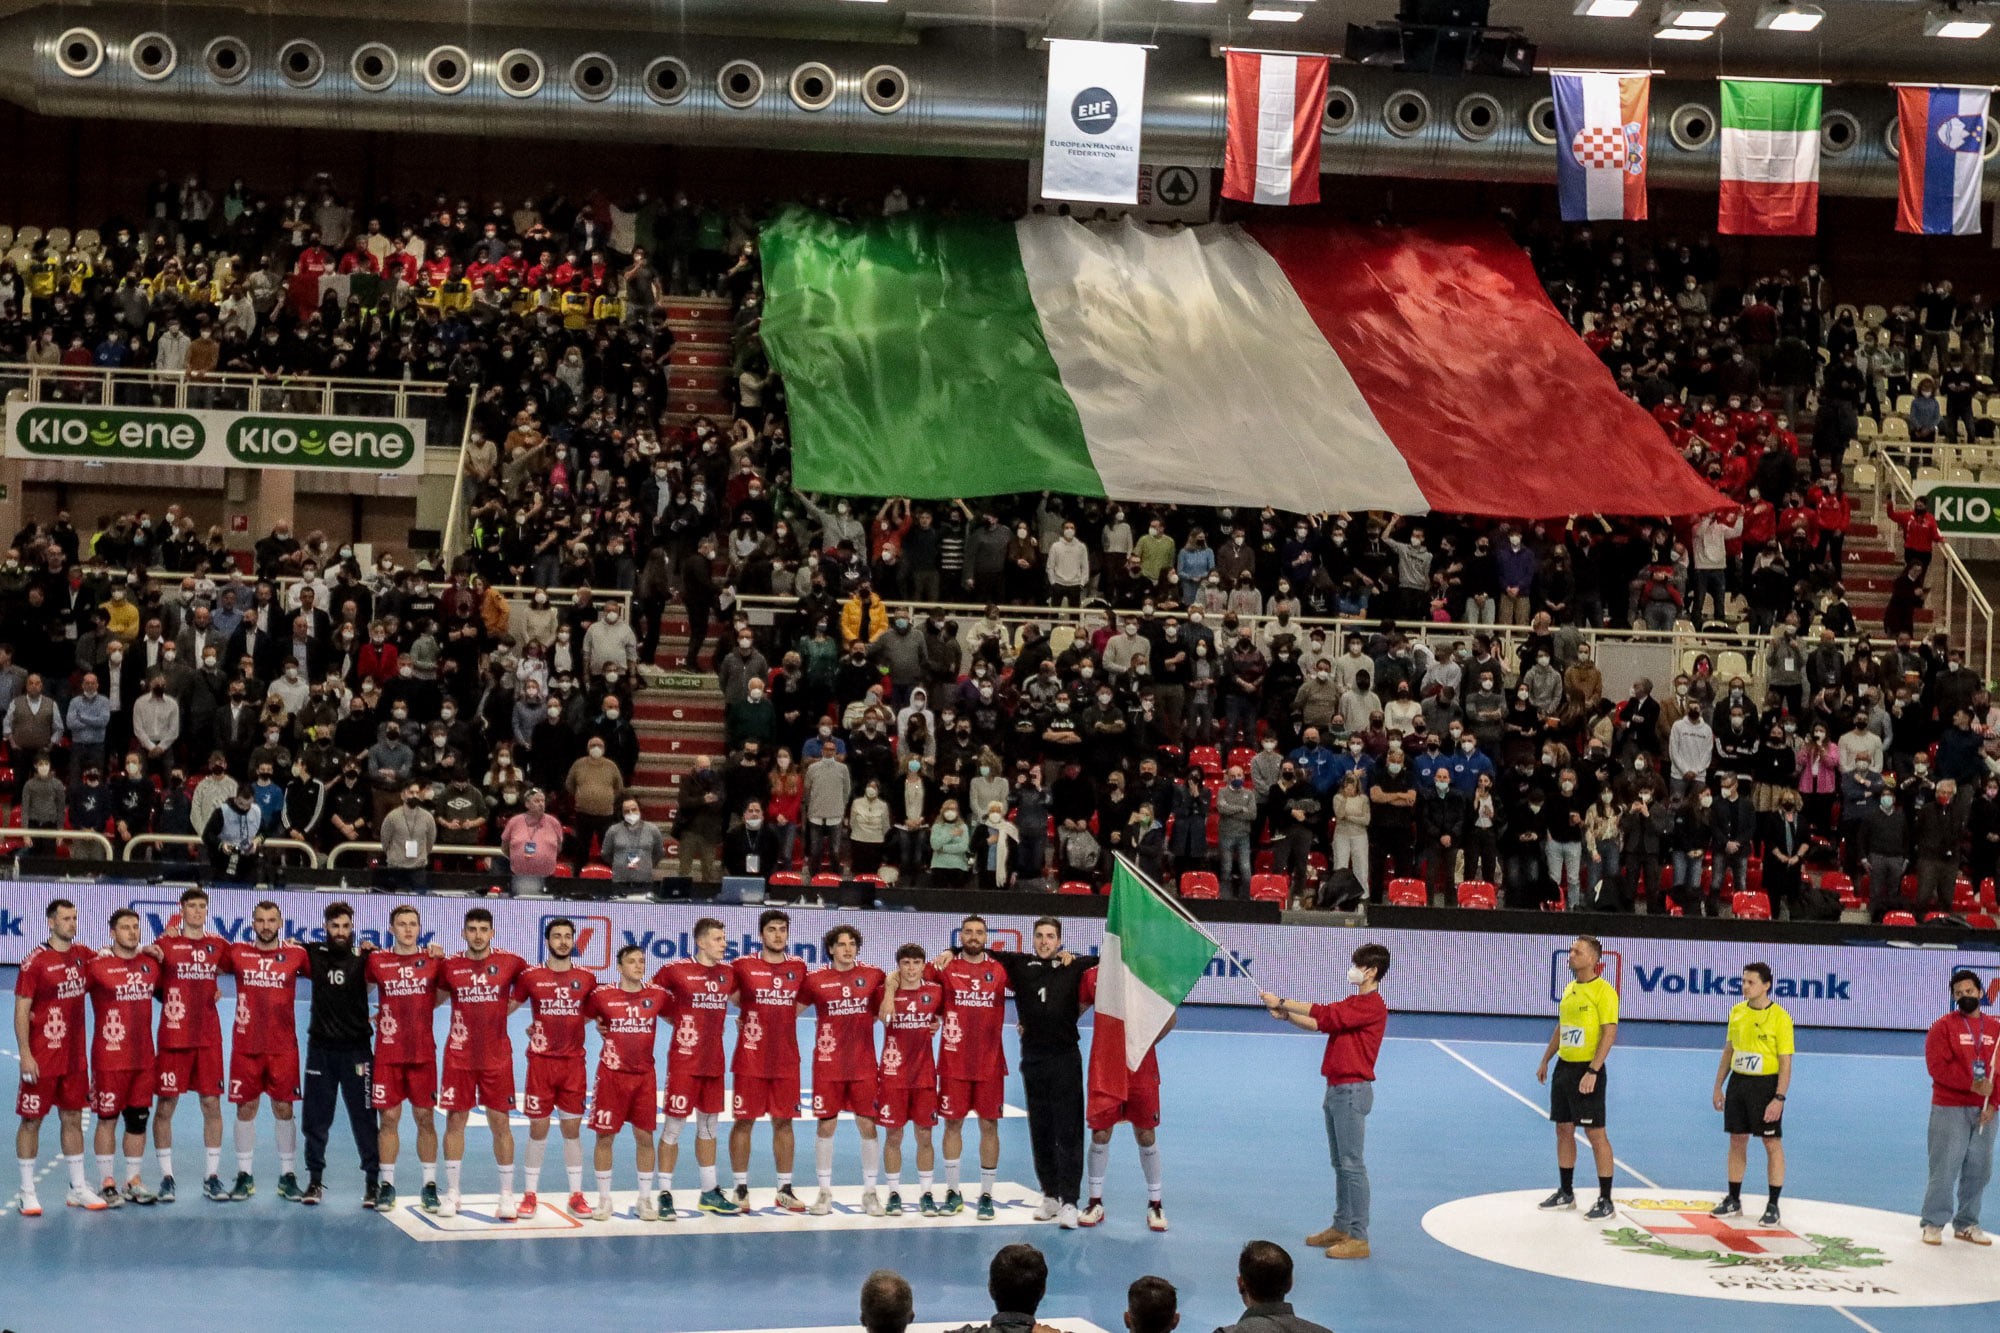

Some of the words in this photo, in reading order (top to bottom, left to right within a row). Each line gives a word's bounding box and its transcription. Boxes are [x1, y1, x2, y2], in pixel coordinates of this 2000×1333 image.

[1078, 100, 1112, 117] EHF
[1050, 139, 1092, 150] EUROPEAN
[1093, 142, 1134, 153] HANDBALL
[1068, 149, 1116, 159] FEDERATION
[1934, 496, 1991, 523] KIO
[1848, 552, 1860, 560] M
[1868, 580, 1876, 589] L
[672, 709, 683, 718] G
[671, 742, 680, 751] F
[191, 950, 206, 962] 19
[177, 962, 217, 973] ITALIA
[257, 958, 274, 971] 17
[65, 966, 79, 980] 25
[126, 972, 143, 985] 22
[177, 972, 215, 980] HANDBALL
[243, 969, 286, 981] ITALIA
[327, 970, 345, 985] 16
[397, 966, 414, 979] 15
[243, 979, 284, 989] HANDBALL
[383, 978, 427, 990] ITALIA
[470, 973, 488, 986] 14
[773, 977, 783, 989] 9
[971, 979, 981, 991] 3
[1633, 964, 1852, 1000] Volksank
[115, 983, 154, 994] ITALIA
[385, 987, 426, 997] HANDBALL
[457, 985, 500, 996] ITALIA
[705, 981, 719, 993] 10
[842, 986, 851, 998] 8
[458, 994, 499, 1003] HANDBALL
[554, 987, 570, 1000] 13
[756, 988, 797, 999] ITALIA
[955, 990, 995, 999] ITALIA
[1037, 987, 1047, 1003] 1
[540, 999, 580, 1009] ITALIA
[756, 997, 793, 1006] HANDBALL
[827, 997, 868, 1010] ITALIA
[907, 1001, 917, 1013] 4
[955, 999, 994, 1008] HANDBALL
[540, 1008, 580, 1016] HANDBALL
[625, 1006, 639, 1018] 11
[828, 1007, 867, 1016] HANDBALL
[610, 1017, 653, 1027] ITALIA
[610, 1024, 652, 1033] HANDBALL
[1568, 1029, 1583, 1045] TV
[1744, 1055, 1760, 1071] TV
[160, 1072, 176, 1087] 19
[22, 1093, 40, 1110] 25
[99, 1092, 115, 1107] 22
[669, 1095, 687, 1110] 10
[733, 1095, 743, 1109] 9
[813, 1095, 823, 1110] 8
[941, 1096, 949, 1110] 3
[880, 1104, 890, 1118] 4
[596, 1109, 612, 1126] 11
[1715, 1281, 1901, 1295] PADOVA
